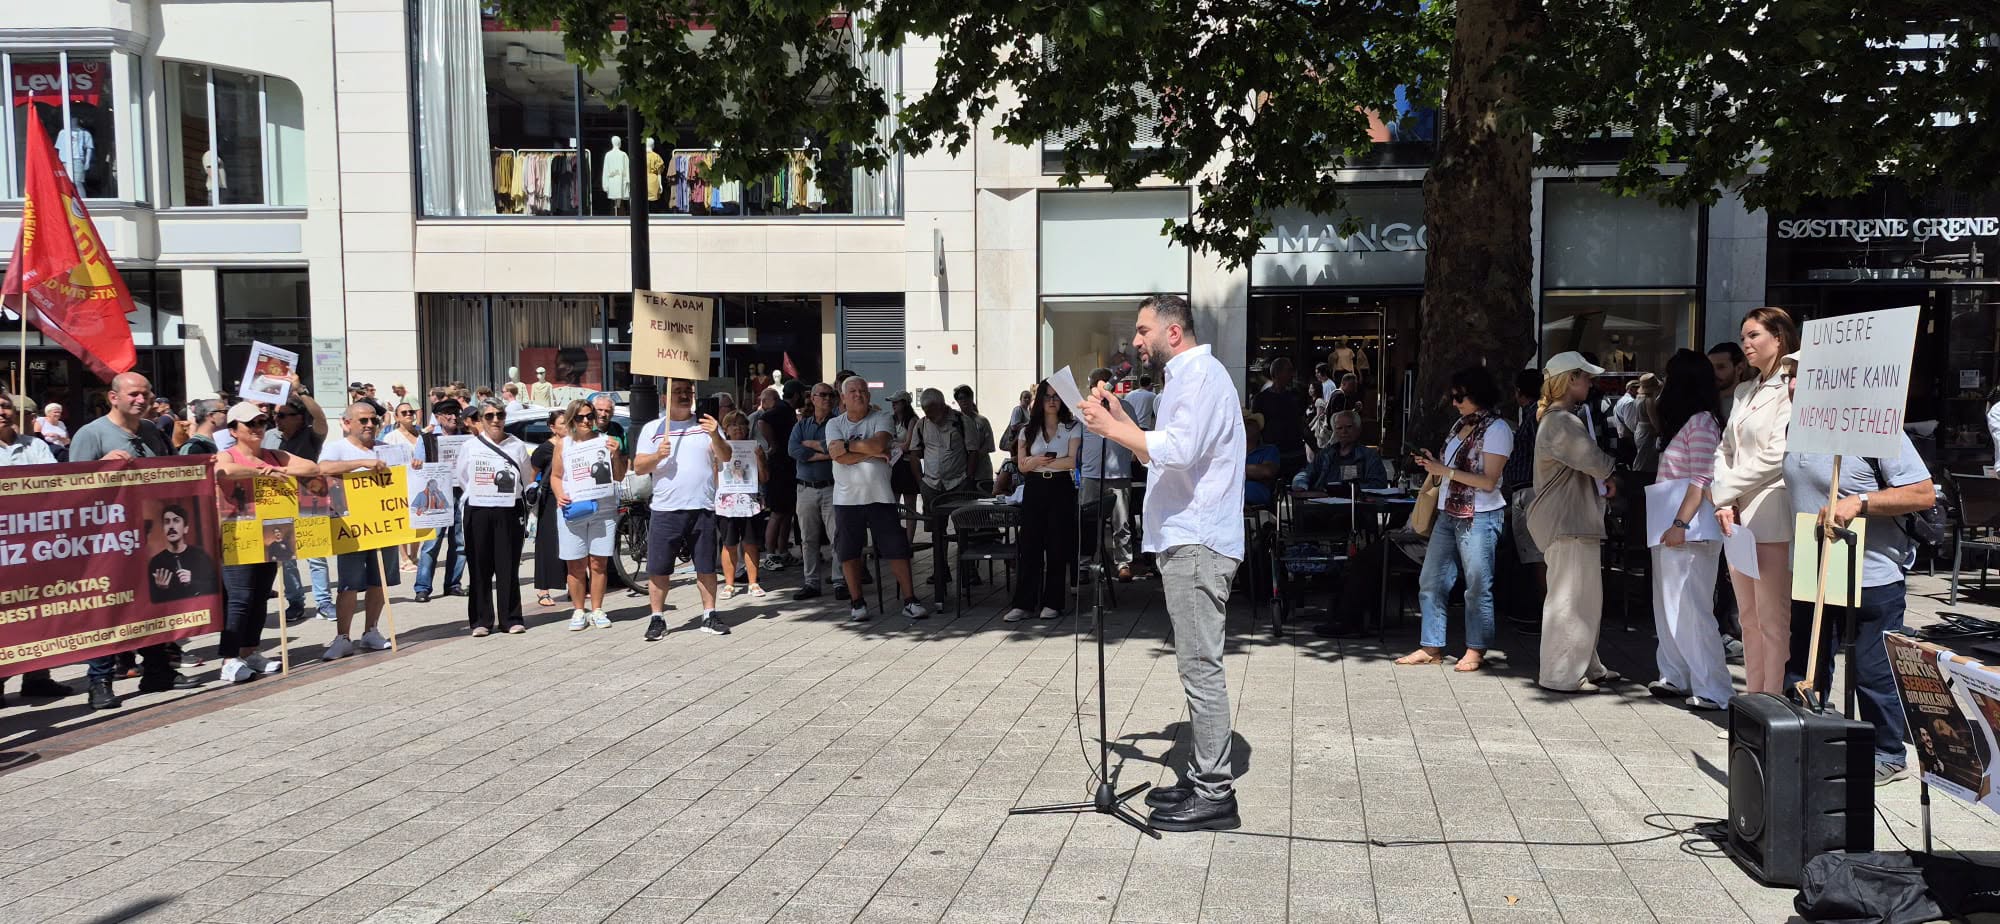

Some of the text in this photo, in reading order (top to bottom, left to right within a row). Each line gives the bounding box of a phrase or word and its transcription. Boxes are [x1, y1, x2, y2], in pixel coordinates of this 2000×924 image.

[1777, 217, 1999, 242] SØSTRENE GRENE
[643, 294, 704, 312] TEK ADAM
[1813, 317, 1875, 346] UNSERE
[1807, 363, 1901, 390] TRÄUME KANN
[1841, 407, 1902, 435] STEHLEN
[22, 478, 67, 491] Kunst-
[70, 472, 95, 485] und
[98, 466, 205, 483] Meinungsfreiheit!
[79, 501, 126, 526] FÜR
[337, 517, 405, 540] ADALET
[32, 529, 141, 562] GÖKTAŞ!
[43, 576, 111, 598] GÖKTAŞ
[41, 589, 135, 617] BIRAKILSIN!
[19, 630, 116, 657] özgürlüğünden
[119, 617, 168, 638] ellerinizi
[169, 611, 208, 630] çekin!
